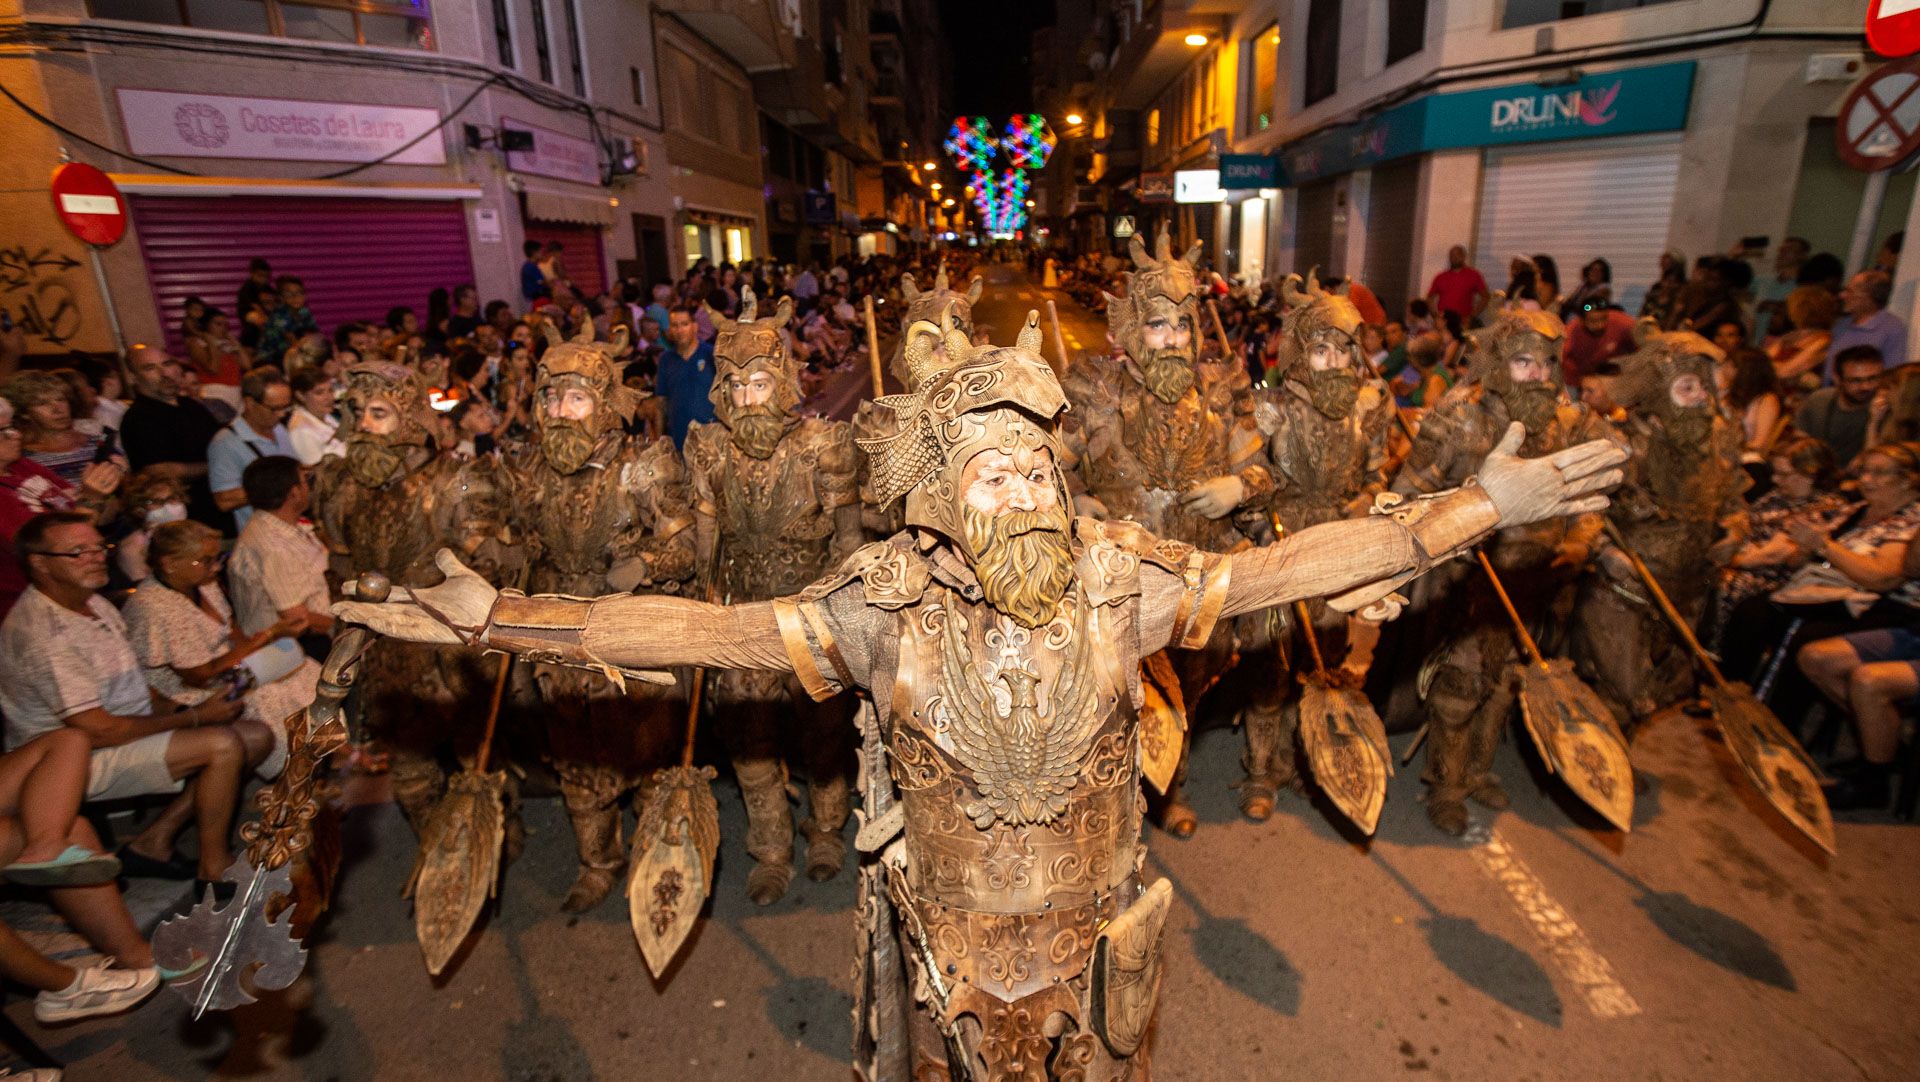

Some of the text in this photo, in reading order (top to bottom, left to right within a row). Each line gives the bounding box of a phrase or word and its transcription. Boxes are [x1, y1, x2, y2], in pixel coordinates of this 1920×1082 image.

[239, 107, 406, 140] Cosetes de Laura
[1491, 91, 1582, 127] DRUNI
